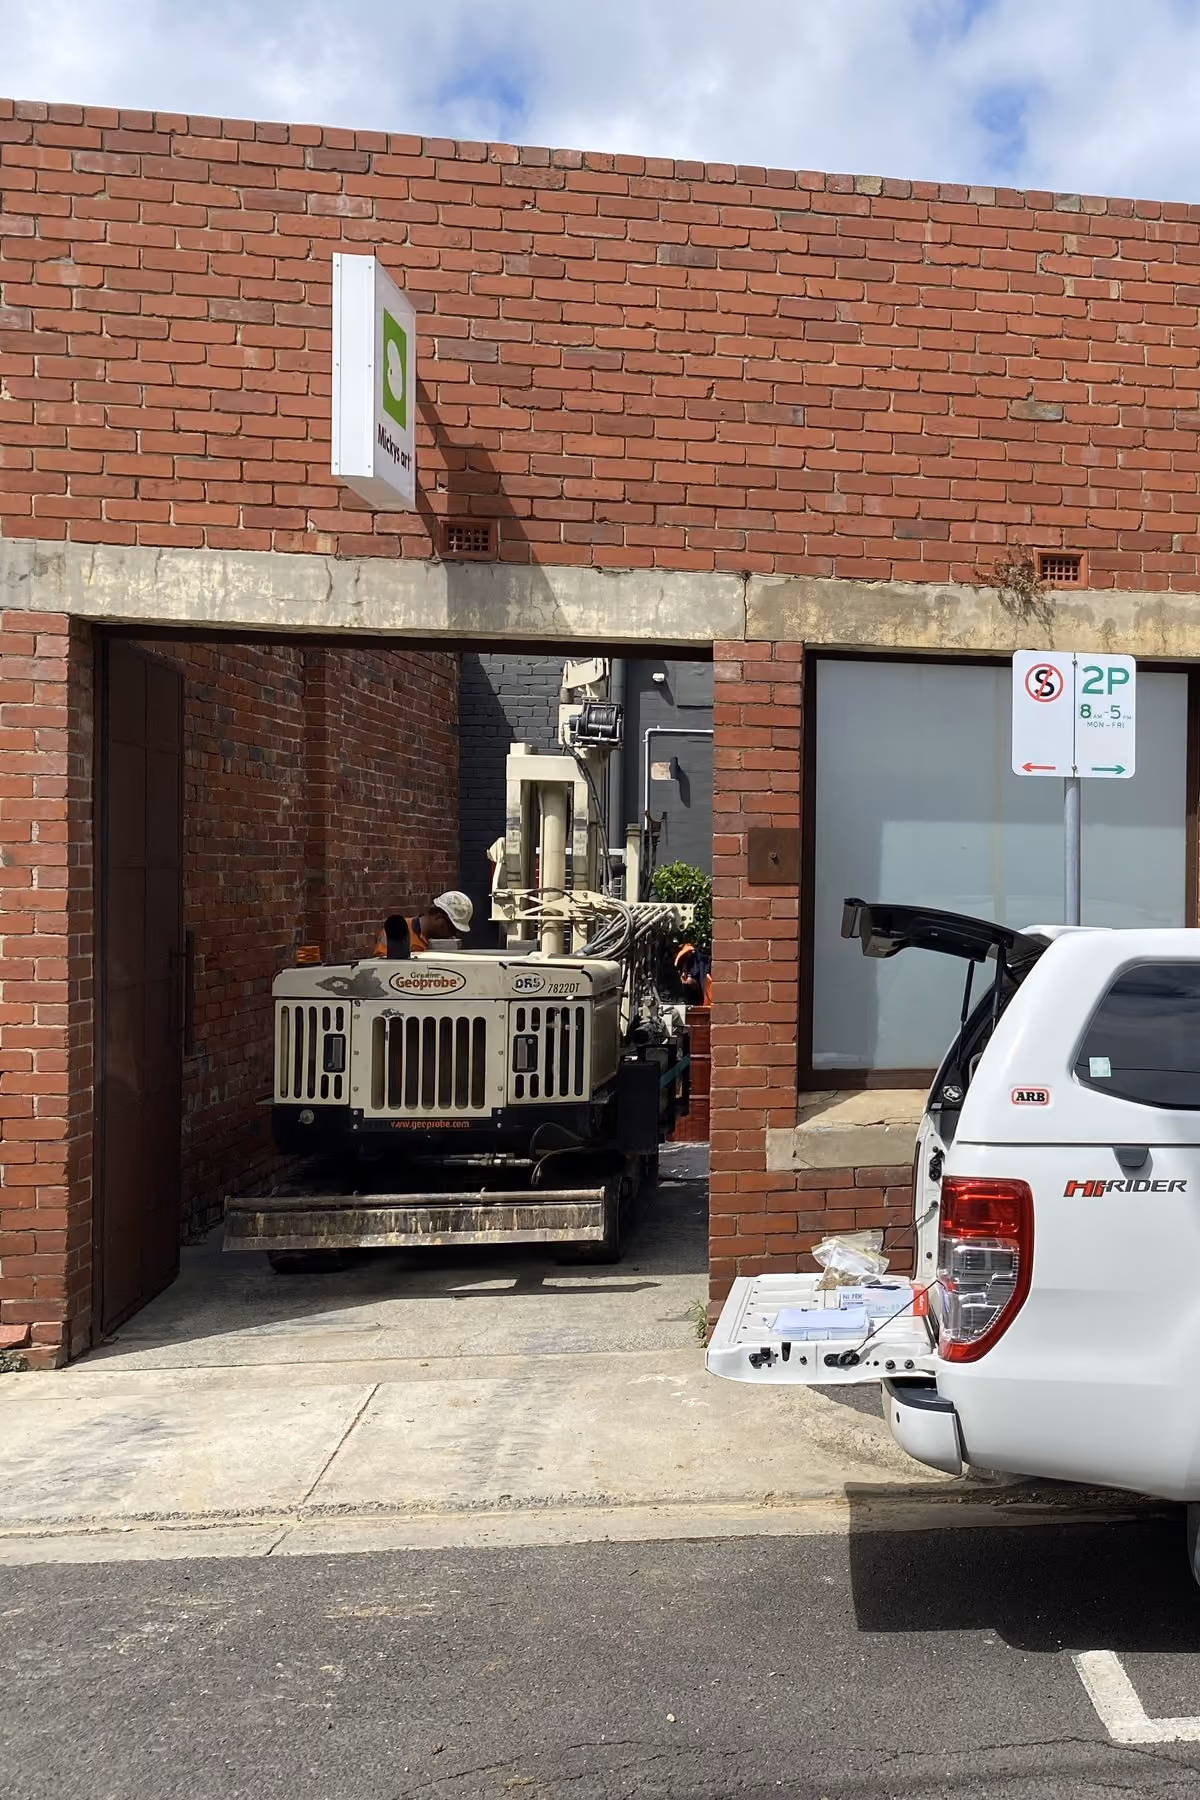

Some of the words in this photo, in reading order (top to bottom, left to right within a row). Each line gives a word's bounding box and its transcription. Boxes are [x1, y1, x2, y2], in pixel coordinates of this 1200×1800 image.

[378, 423, 399, 464] Mickys
[1082, 666, 1130, 695] 2P
[395, 976, 457, 990] Geoprobe
[1016, 1091, 1046, 1103] ARB
